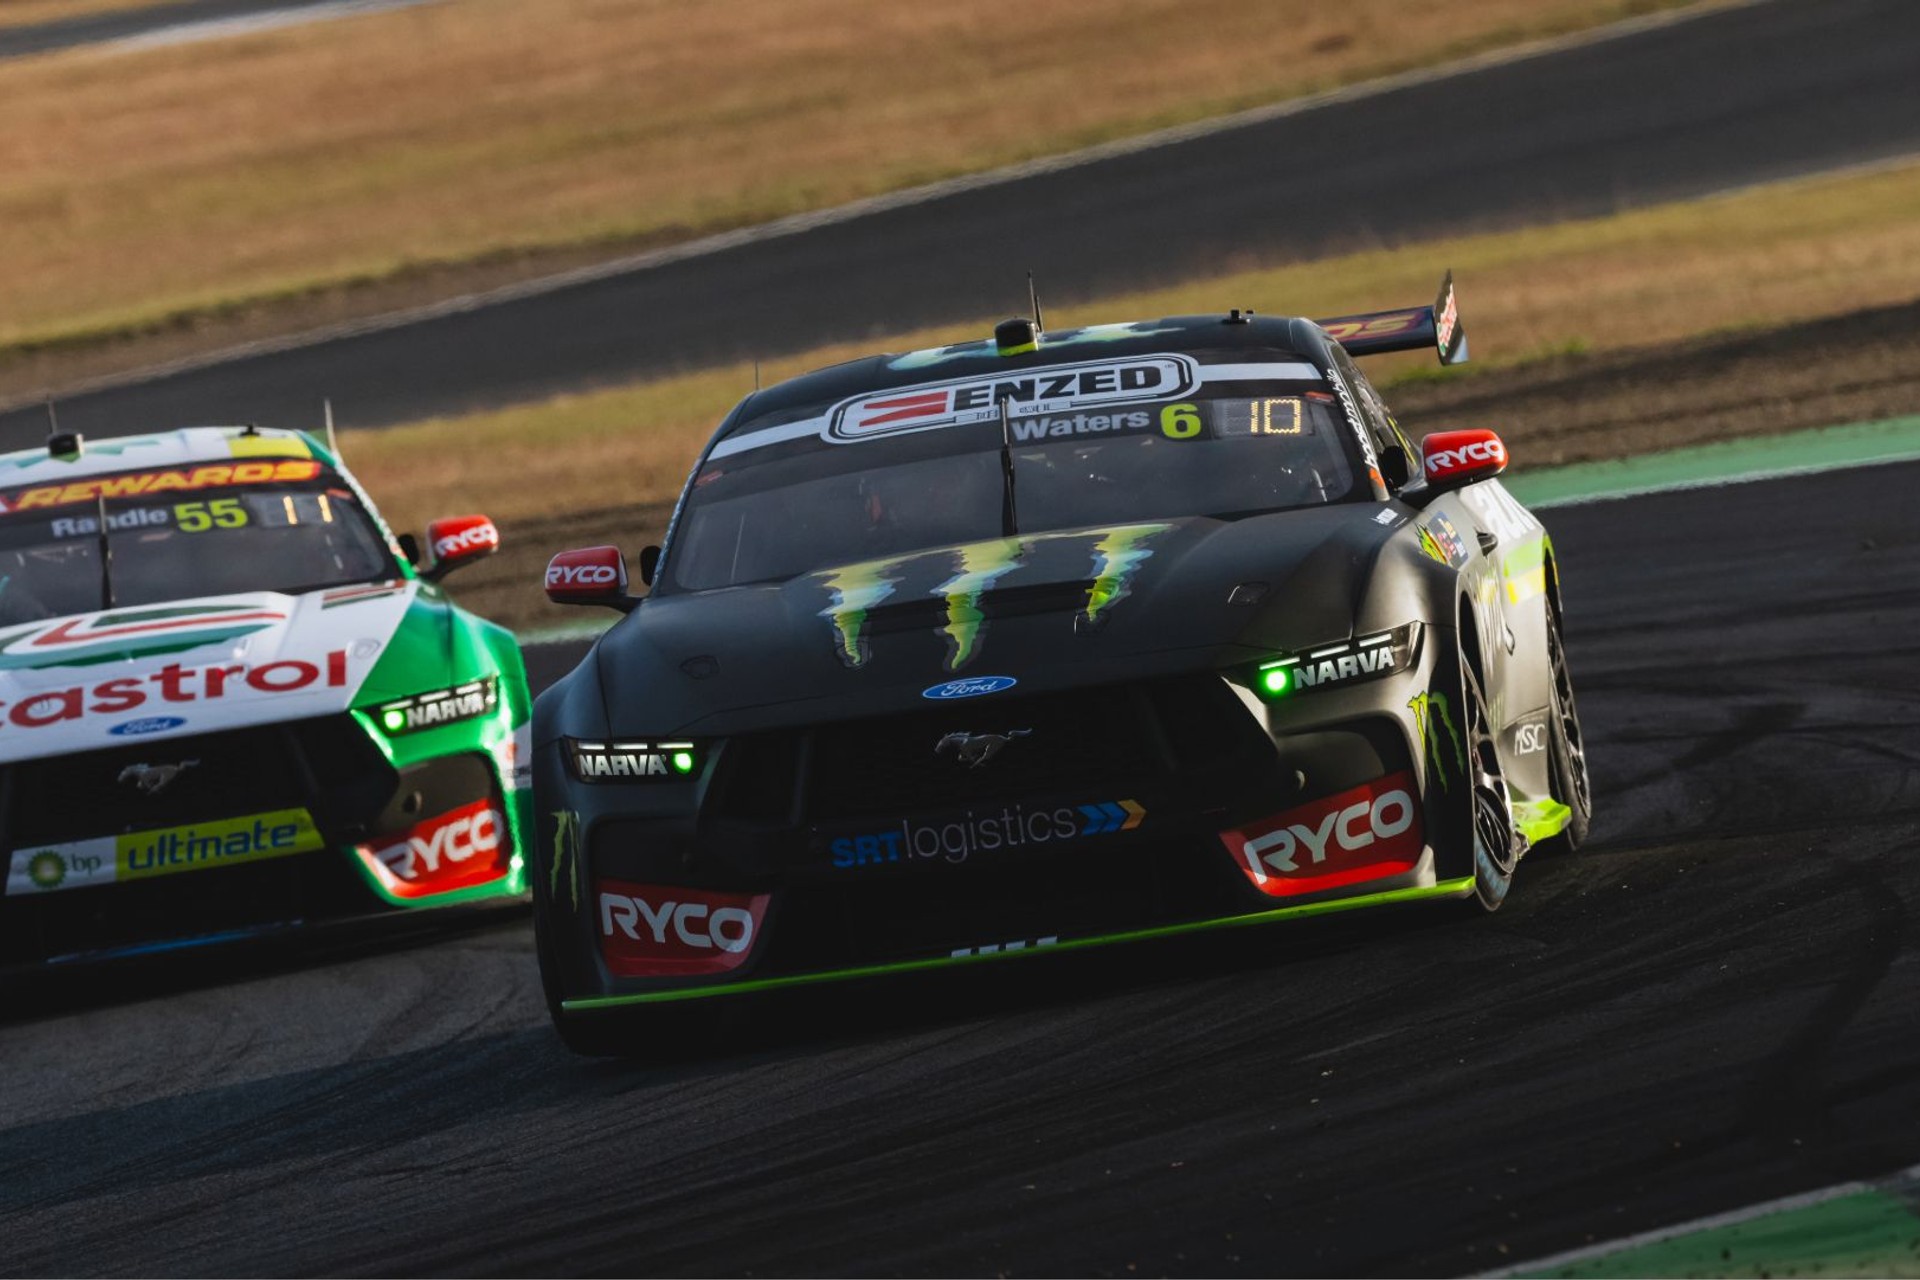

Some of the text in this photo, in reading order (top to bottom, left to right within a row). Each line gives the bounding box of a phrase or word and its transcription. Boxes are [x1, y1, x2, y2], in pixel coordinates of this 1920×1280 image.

[953, 365, 1162, 411] ENZED
[1010, 405, 1150, 441] Waters
[1159, 403, 1201, 438] 6
[1250, 398, 1302, 434] 10
[1425, 440, 1504, 473] RYCO
[16, 462, 320, 510] REWARDS
[51, 498, 247, 537] Randle 55
[436, 524, 498, 556] RYCO
[548, 565, 616, 584] RYCO
[1294, 647, 1396, 690] NARVA
[0, 650, 347, 728] astrol
[942, 680, 998, 697] Ford
[122, 719, 172, 734] Ford
[405, 693, 485, 729] NARVA
[579, 754, 667, 776] NARVA
[71, 820, 298, 876] bp ultimate
[379, 809, 502, 879] RYCO
[1244, 790, 1414, 885] RYCO
[600, 892, 754, 953] RYCO
